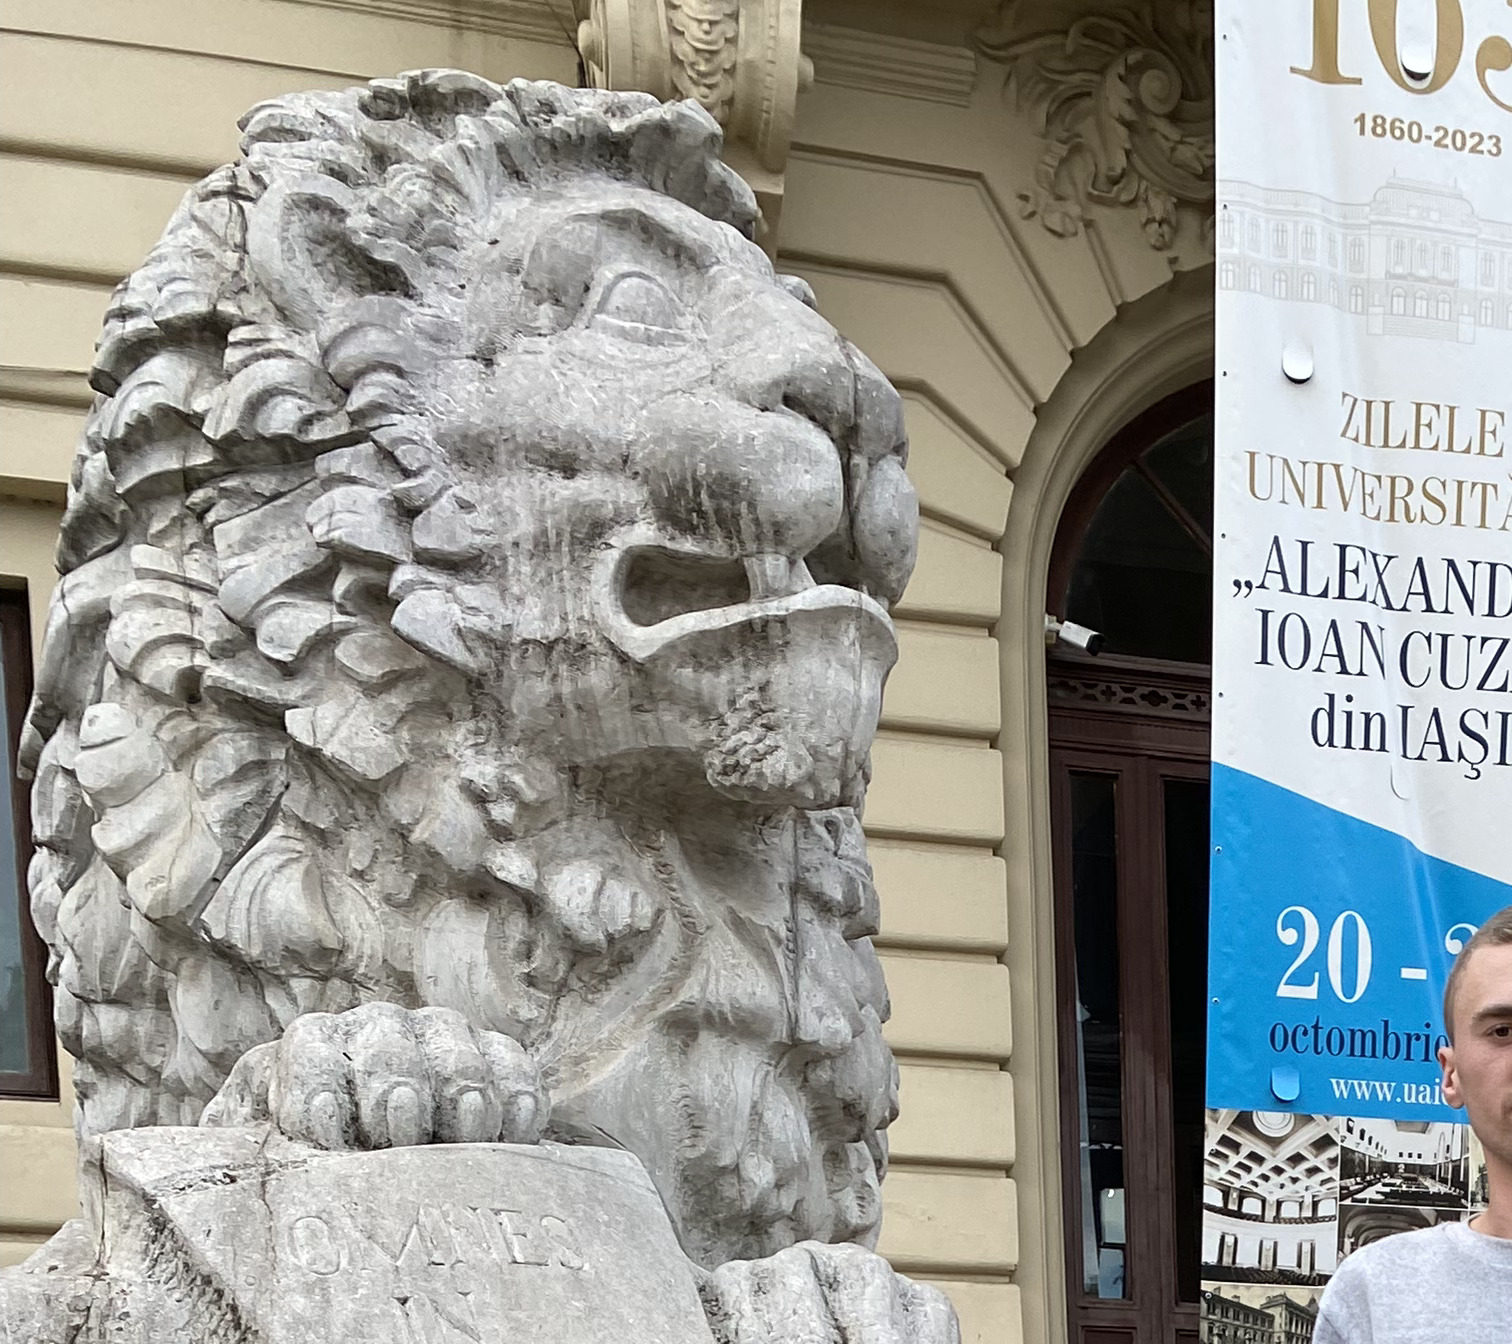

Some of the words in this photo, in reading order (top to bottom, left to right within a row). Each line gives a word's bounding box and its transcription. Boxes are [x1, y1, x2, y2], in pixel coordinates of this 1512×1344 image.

[1353, 112, 1502, 158] 1860-2023
[1340, 390, 1506, 458] ZILELE
[1254, 607, 1387, 681] IOAN
[1310, 692, 1390, 754] din
[1275, 905, 1373, 1004] 20
[1329, 1077, 1449, 1106] www.uai
[289, 1202, 586, 1276] OMNES
